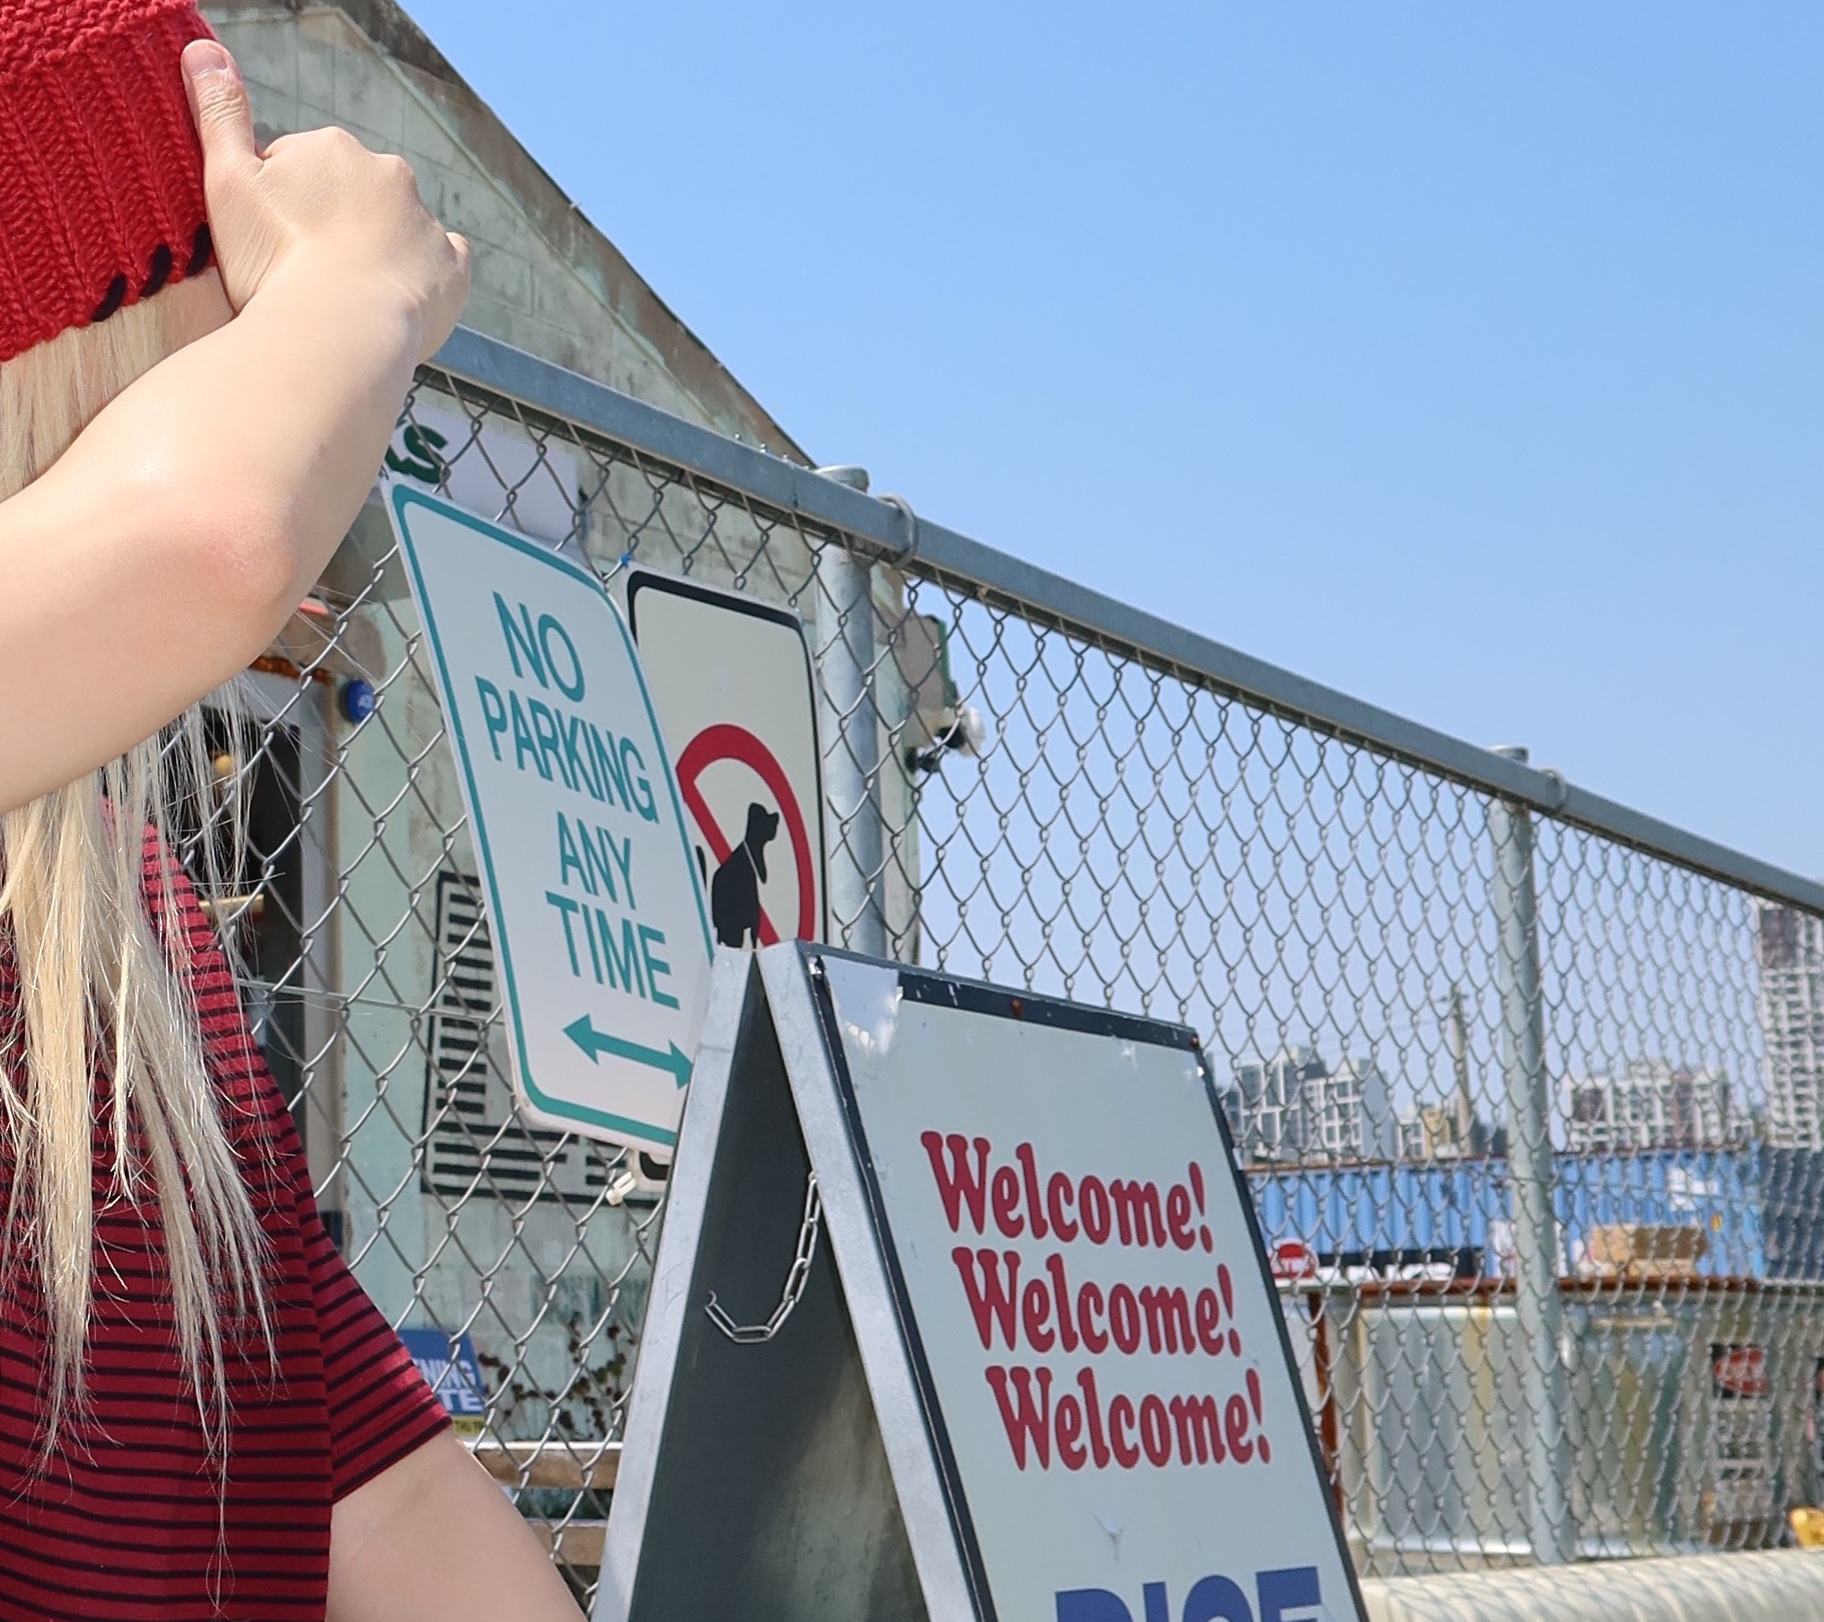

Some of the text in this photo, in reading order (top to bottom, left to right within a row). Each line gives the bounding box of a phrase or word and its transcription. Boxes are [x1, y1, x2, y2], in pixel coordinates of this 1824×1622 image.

[493, 592, 586, 703] NO
[475, 676, 659, 822] PARKING
[557, 811, 634, 909] ANY
[545, 891, 680, 1010] TIME
[921, 1131, 1214, 1253] Welcome!
[952, 1247, 1241, 1358] Welcome!
[412, 1358, 477, 1389] NING
[985, 1366, 1270, 1471] Welcome!
